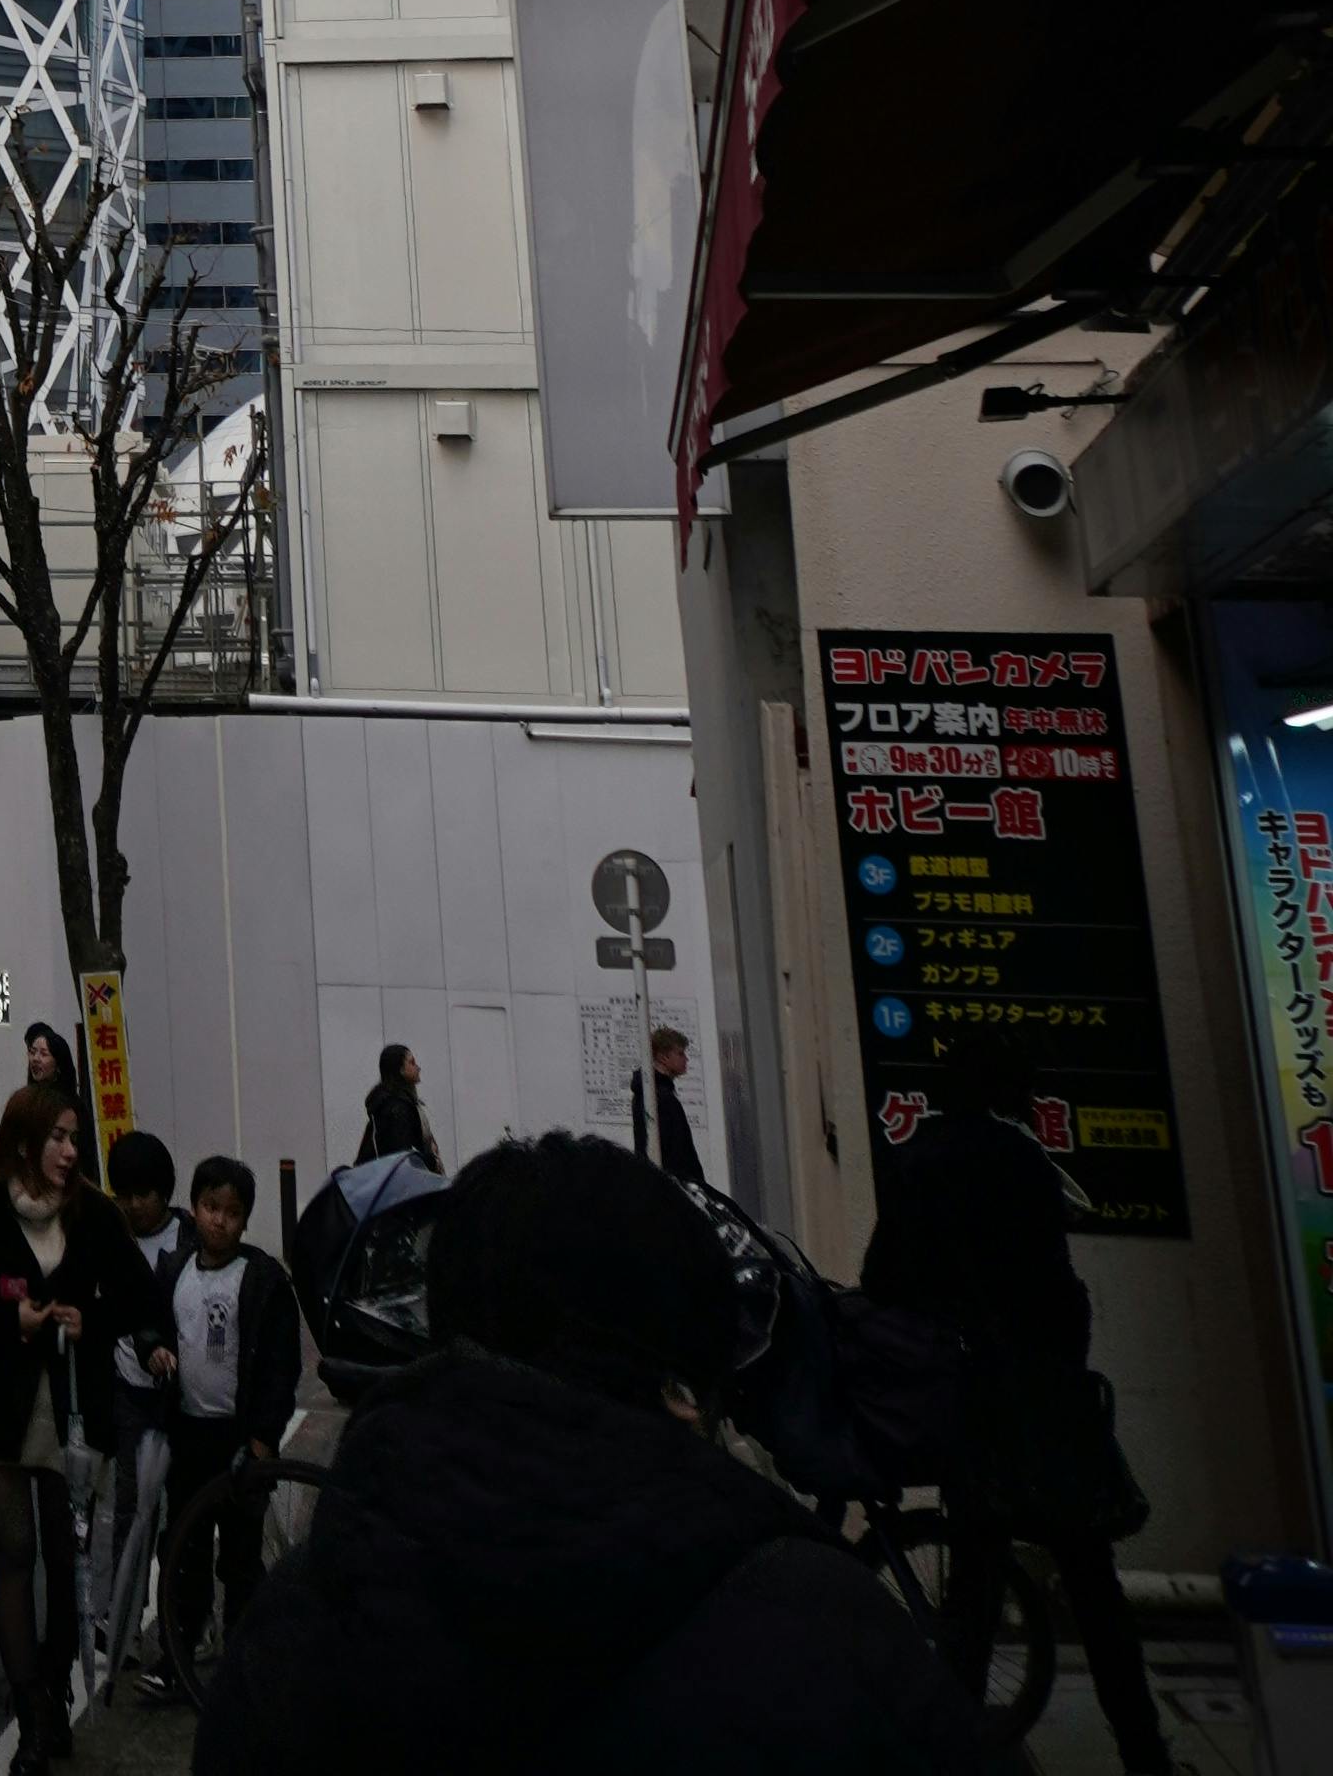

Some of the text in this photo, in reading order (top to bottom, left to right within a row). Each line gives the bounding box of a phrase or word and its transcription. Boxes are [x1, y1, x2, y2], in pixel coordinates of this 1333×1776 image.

[830, 648, 1106, 688] ヨドバシカメラ
[835, 702, 1108, 737] フロア案内 年中無休
[847, 784, 1046, 840] ホビー館
[862, 863, 891, 886] 3F
[872, 927, 1016, 958] 2F フィギュア
[1258, 809, 1327, 1108] キャラクターグッズも
[881, 1001, 1107, 1028] 1F キャラクターグッズ
